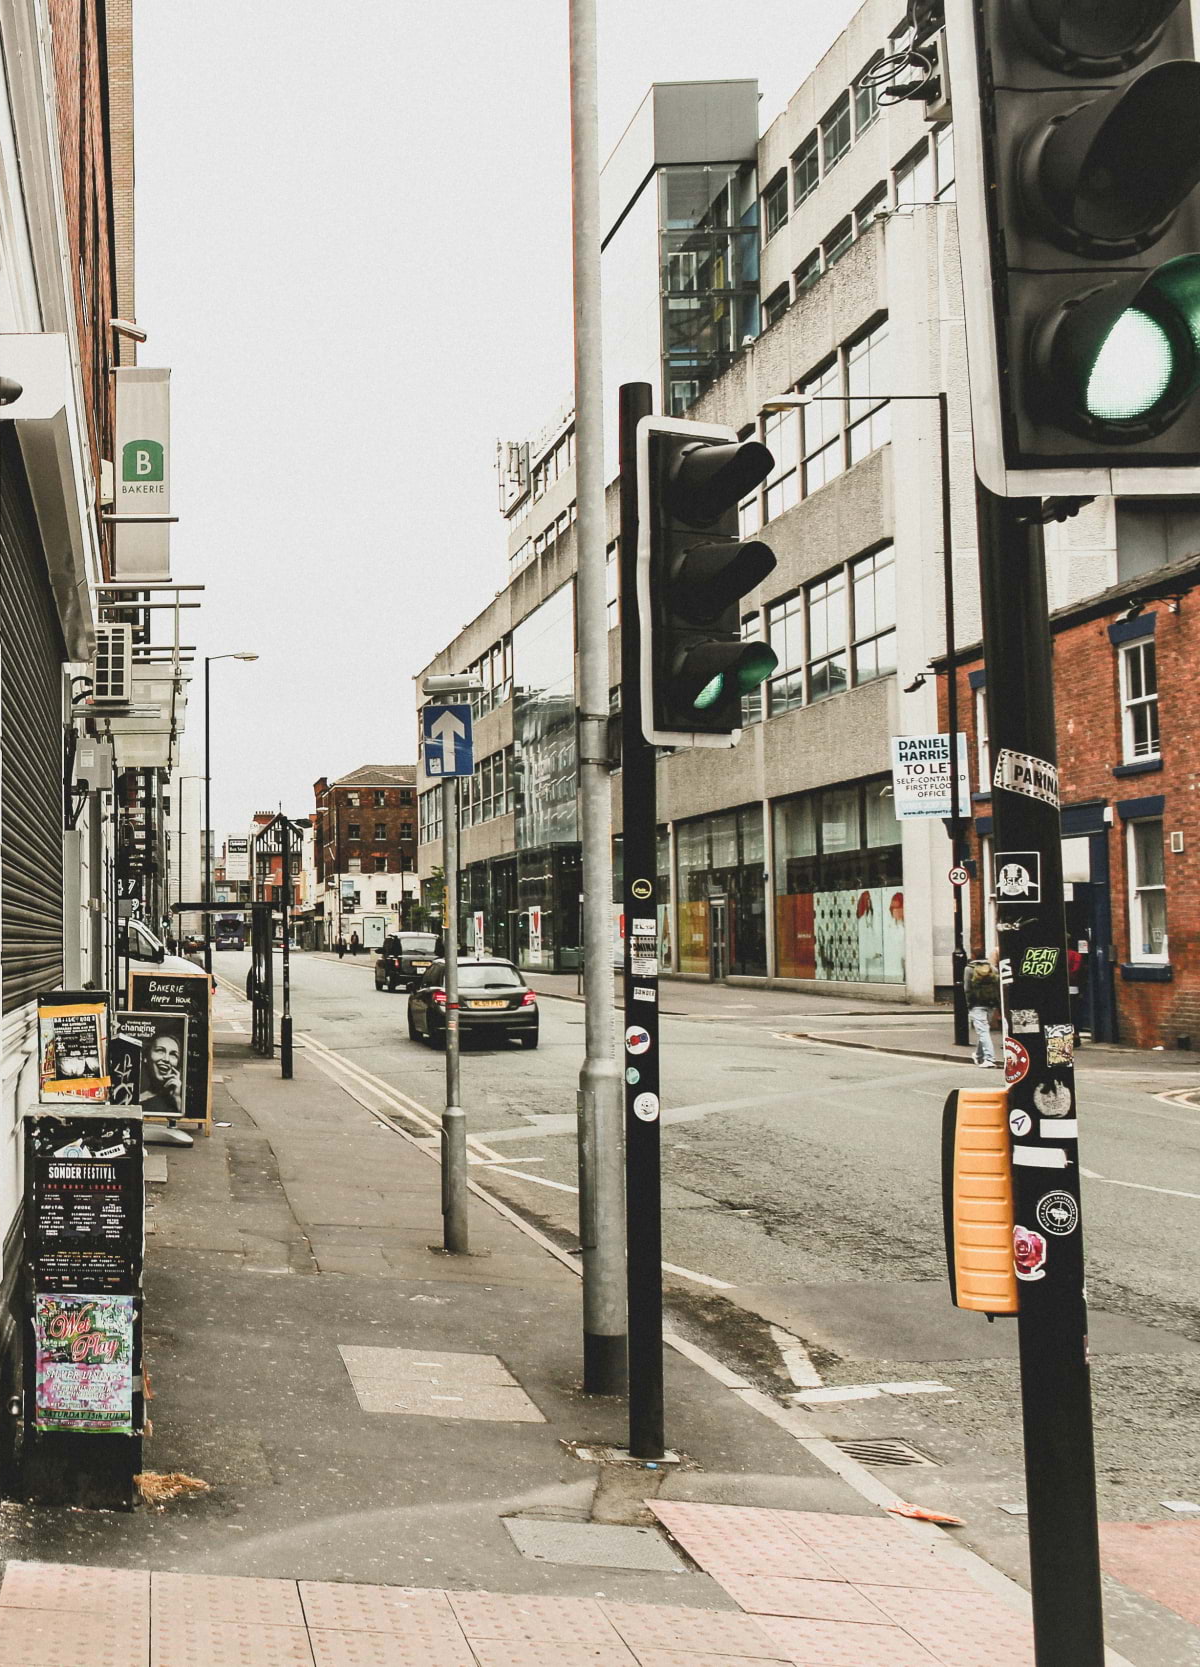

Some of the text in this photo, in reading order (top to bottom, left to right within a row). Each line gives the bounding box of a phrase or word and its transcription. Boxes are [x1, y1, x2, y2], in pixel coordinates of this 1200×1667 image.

[136, 450, 152, 475] B
[122, 484, 164, 494] BAKERIE
[898, 738, 948, 750] DANIEL
[898, 749, 949, 762] HARRIS
[904, 764, 925, 776] TO
[952, 871, 966, 880] 20
[1026, 948, 1058, 965] DEATH
[1022, 961, 1054, 975] BIRD
[149, 981, 184, 993] BAKERIE
[121, 1023, 156, 1034] changing
[48, 1167, 116, 1182] SONDER FESTIVAL
[50, 1303, 94, 1340] Wet
[71, 1332, 118, 1363] Play
[43, 1410, 85, 1418] SATURDAY
